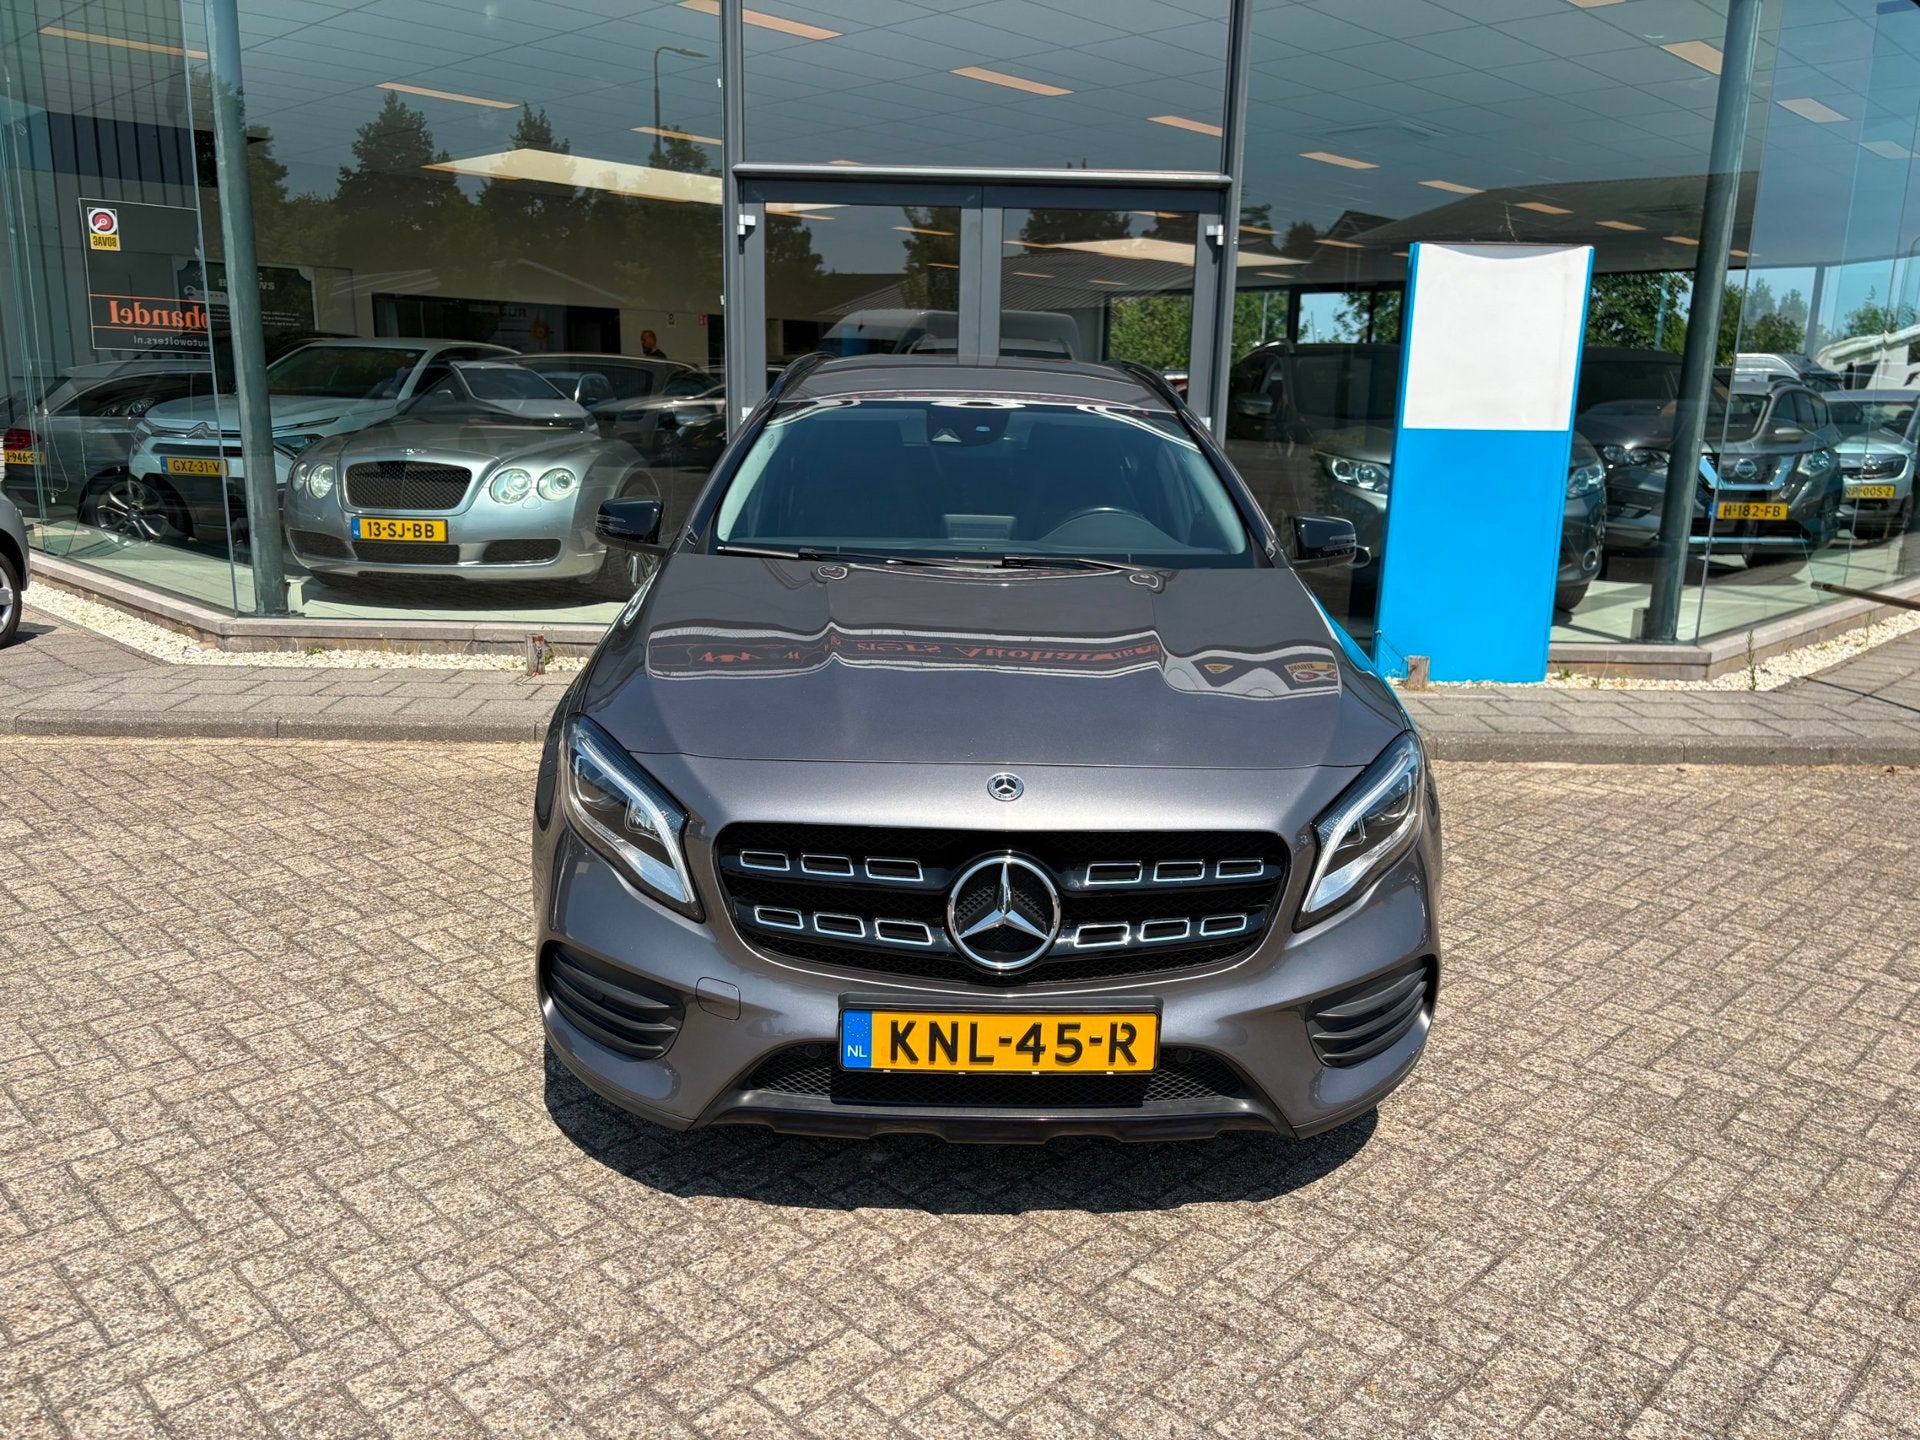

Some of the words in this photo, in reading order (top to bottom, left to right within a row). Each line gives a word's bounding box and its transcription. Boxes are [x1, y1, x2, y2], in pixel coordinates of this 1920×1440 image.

[6, 452, 43, 463] J-946-S
[173, 460, 221, 473] GXZ-31-V
[367, 521, 435, 539] 13-SJ-BB
[847, 1044, 867, 1058] NL
[889, 1020, 1138, 1066] KNL-45-R
